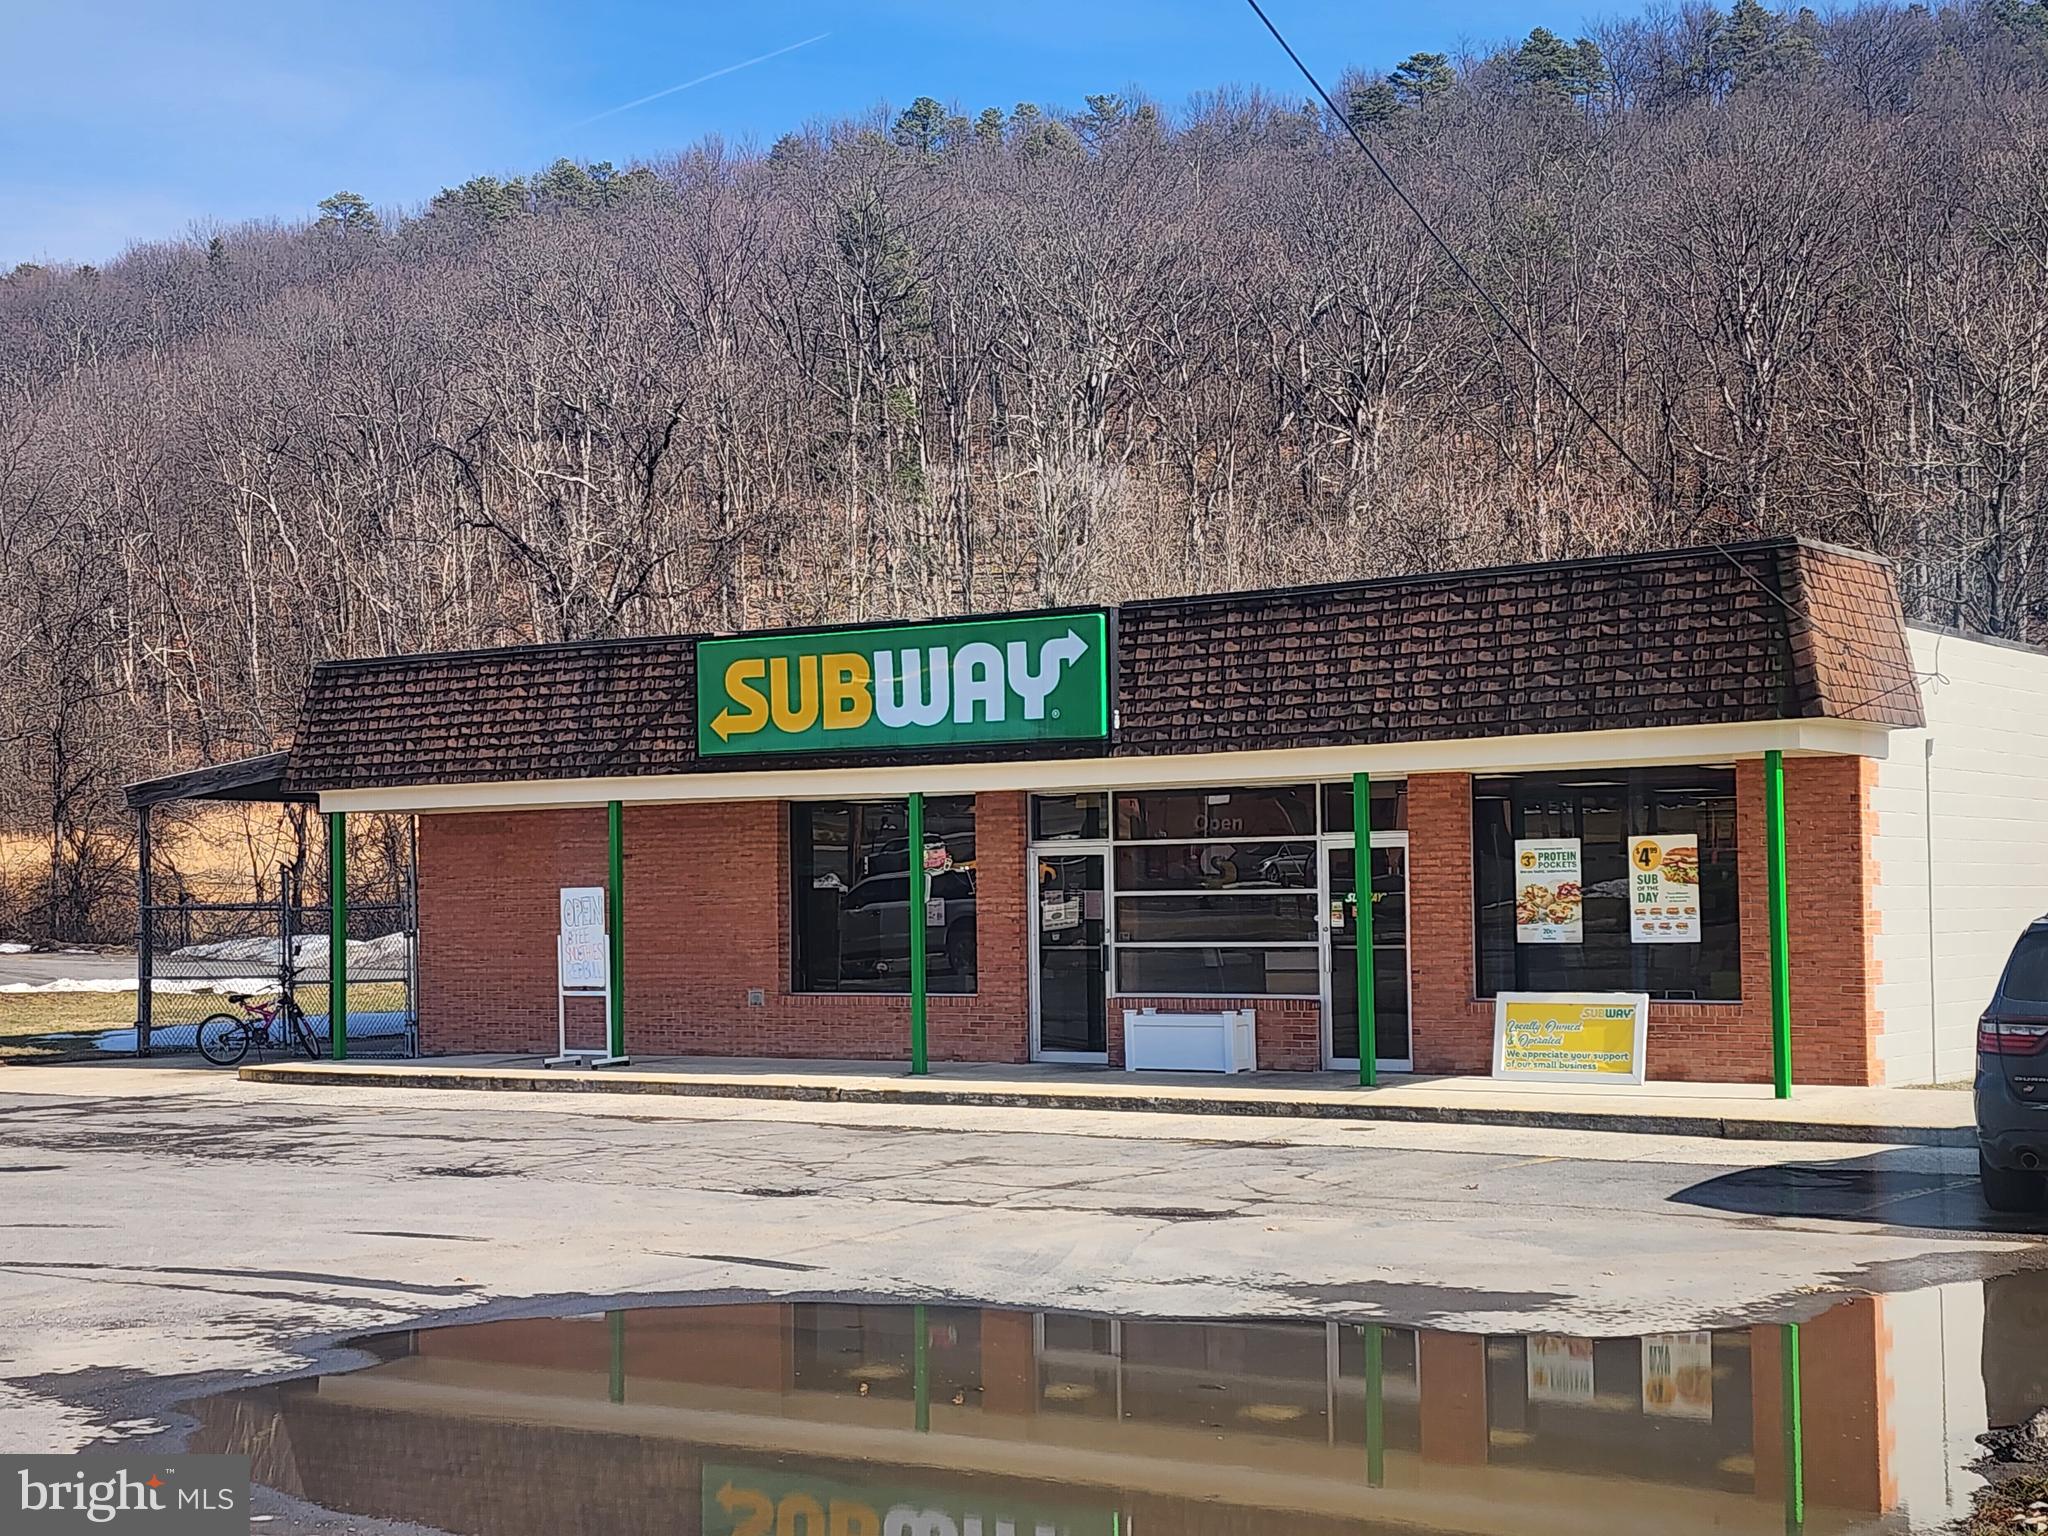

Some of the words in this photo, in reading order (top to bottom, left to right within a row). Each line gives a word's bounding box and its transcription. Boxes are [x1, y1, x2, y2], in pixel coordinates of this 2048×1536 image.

[710, 628, 1089, 742] SUBWAY
[1195, 814, 1243, 834] Open
[1538, 852, 1577, 861] PROTEIN
[1637, 874, 1658, 885] SUB
[1638, 892, 1659, 903] DAY
[564, 896, 603, 927] OPEN
[1582, 1009, 1633, 1018] SUBWAY
[1507, 1020, 1541, 1033] Locally
[1545, 1020, 1581, 1032] Owned
[1519, 1034, 1562, 1046] Operated
[1507, 1050, 1520, 1058] We
[1522, 1050, 1569, 1060] appreciate
[1571, 1052, 1591, 1061] your
[1594, 1052, 1629, 1063] support
[1506, 1060, 1515, 1068] of
[1533, 1060, 1557, 1069] small
[1559, 1061, 1597, 1070] business
